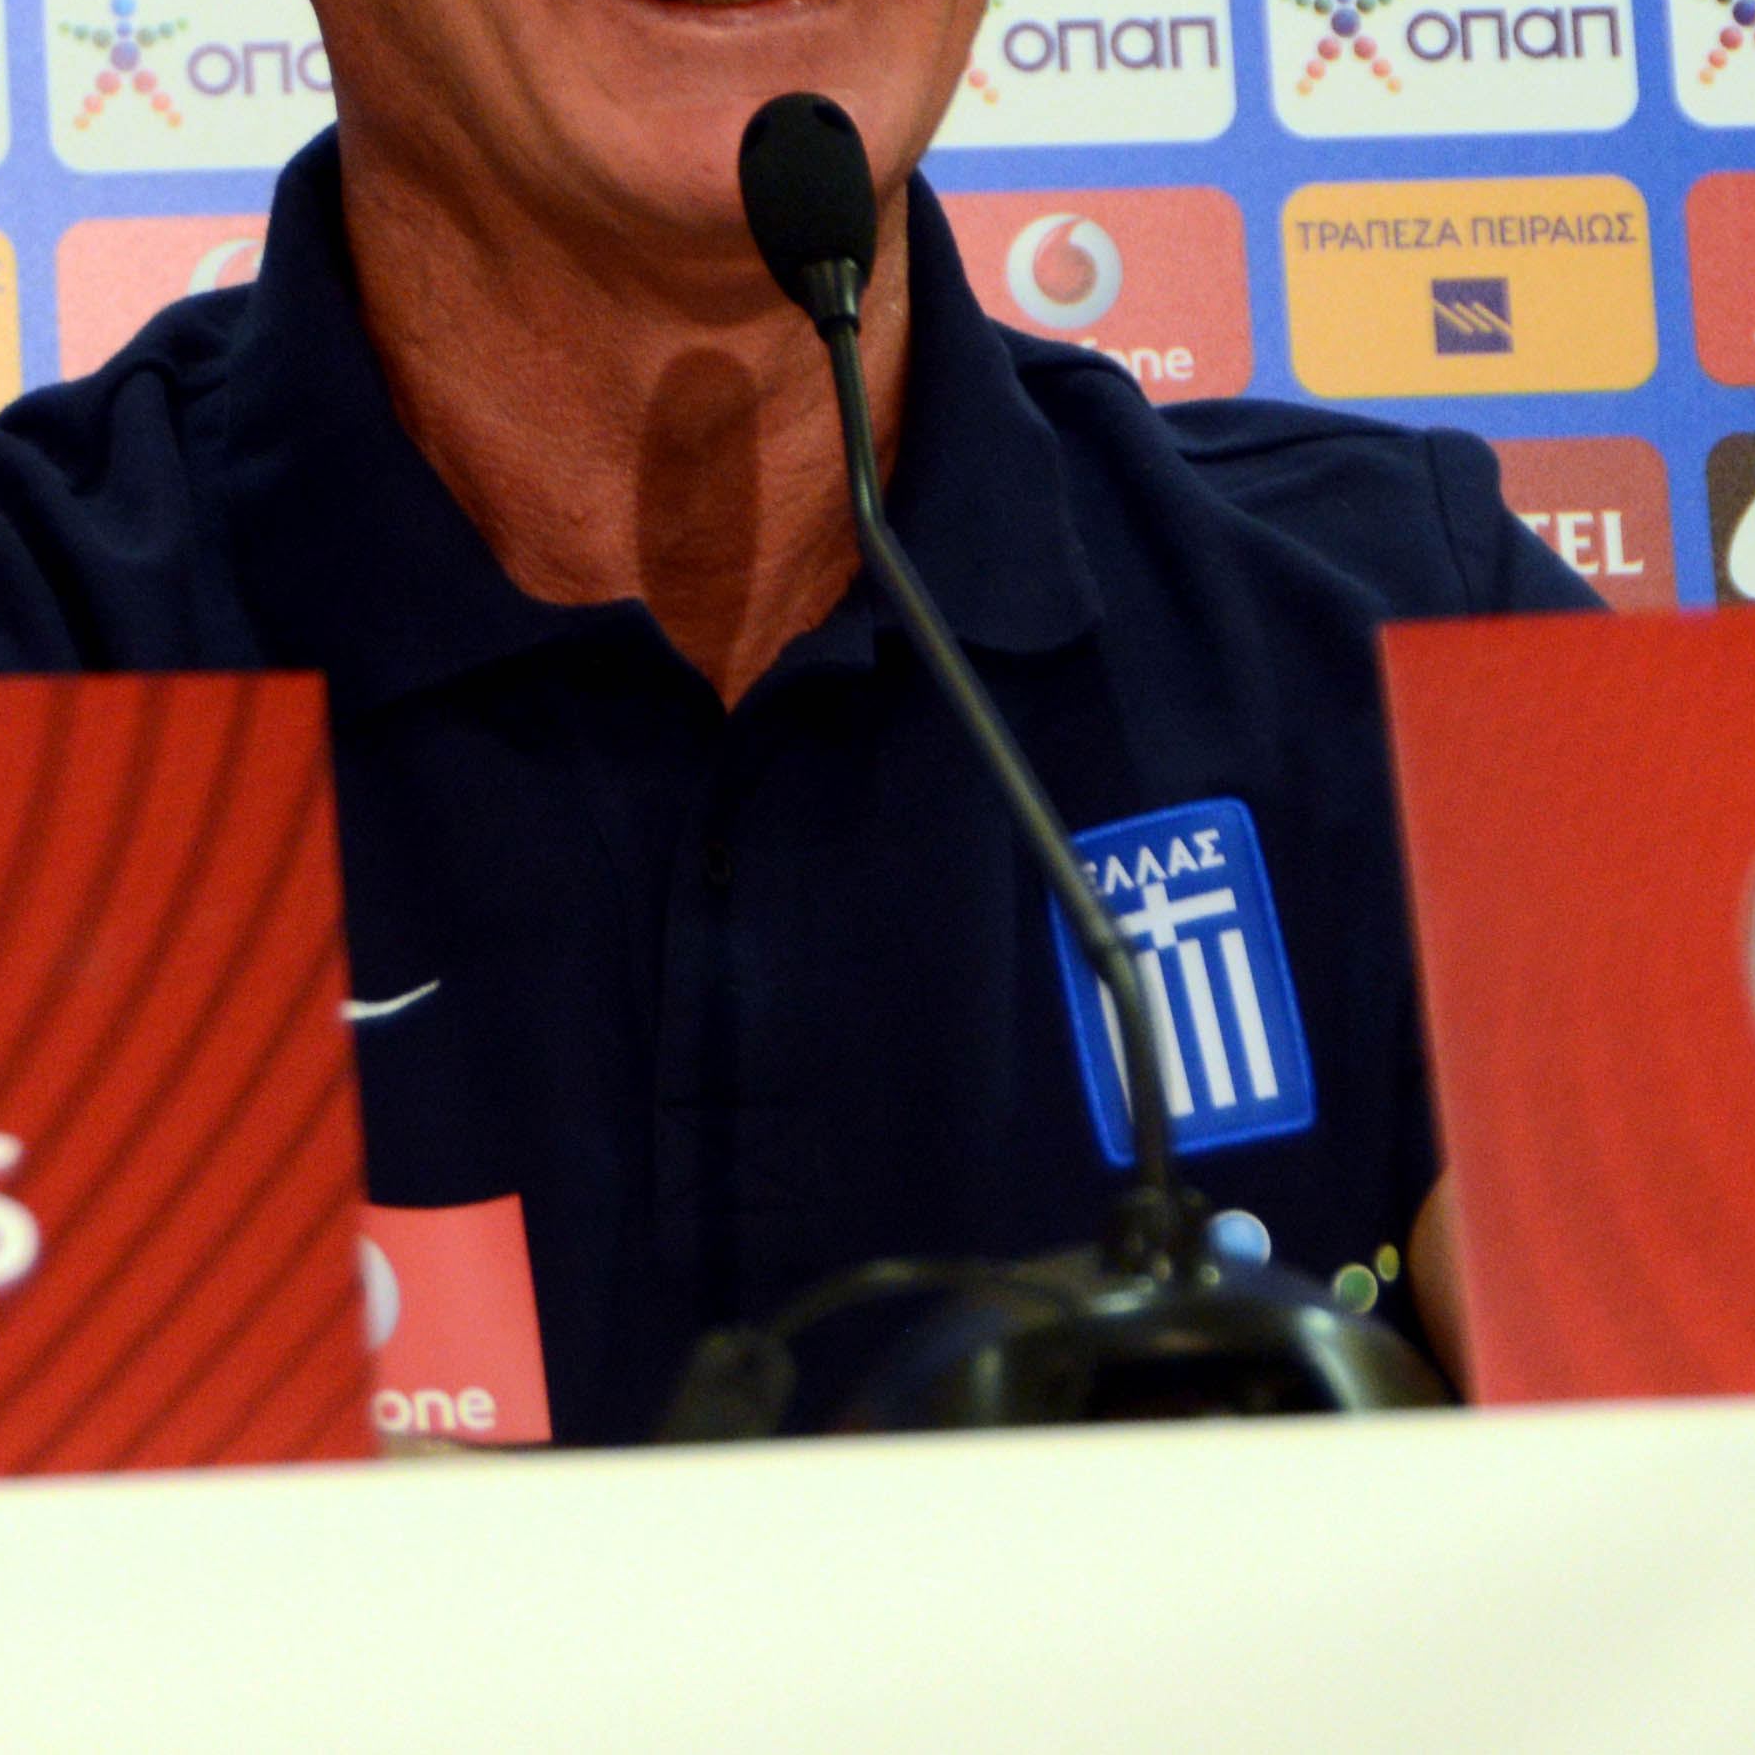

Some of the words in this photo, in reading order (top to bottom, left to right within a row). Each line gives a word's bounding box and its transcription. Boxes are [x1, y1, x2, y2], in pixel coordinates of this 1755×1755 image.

[187, 39, 333, 96] οπα
[1296, 216, 1462, 252] ΤΡΑΠΕΖΑ
[1470, 211, 1638, 246] ΠΕΙΡΑΙΩΣ
